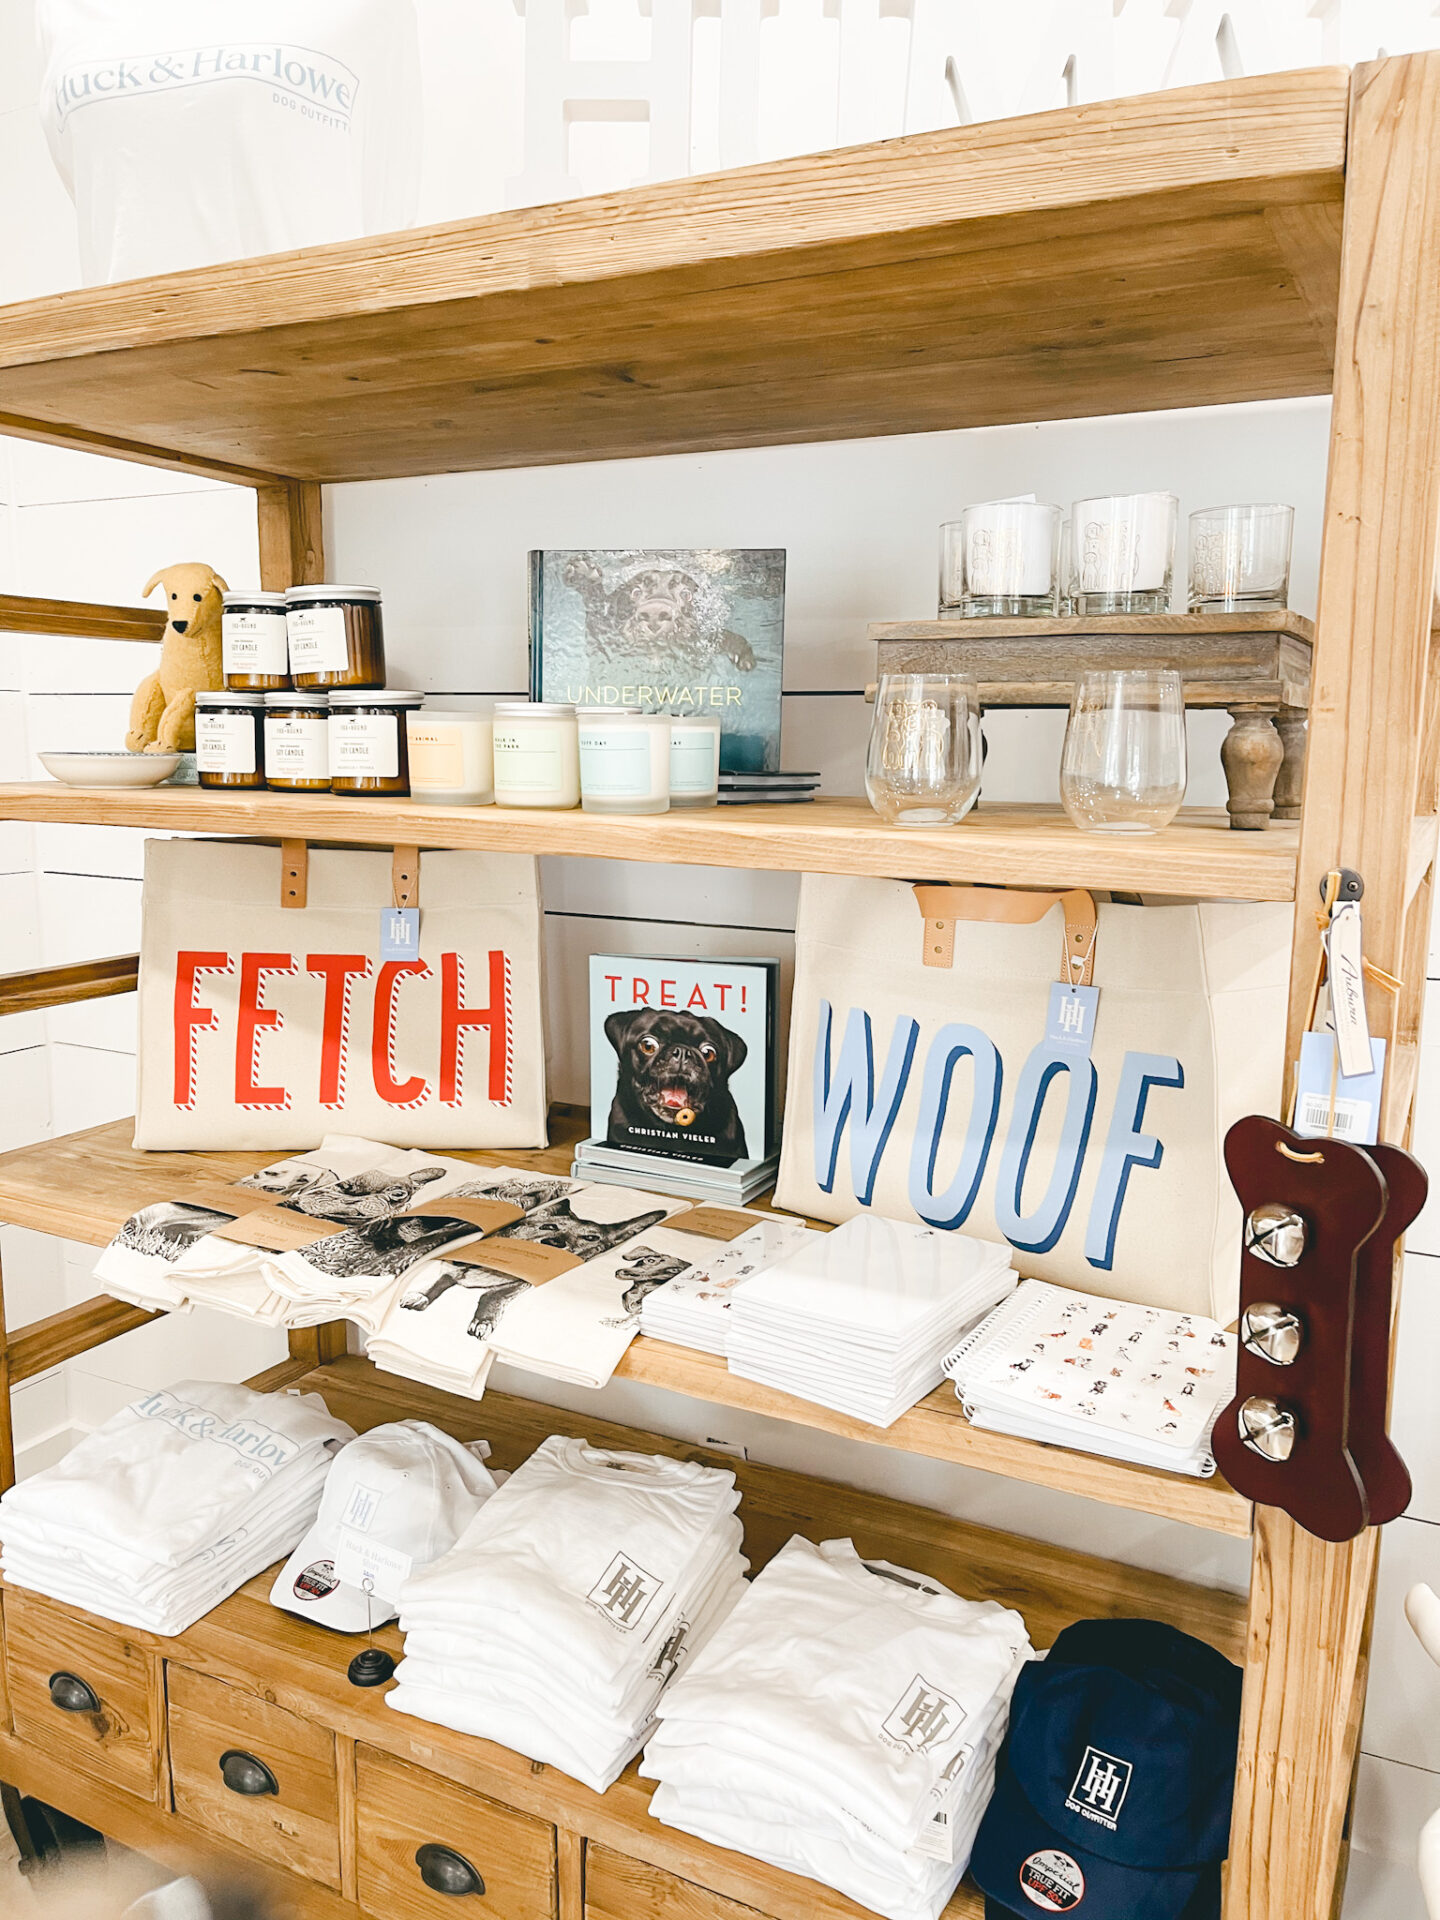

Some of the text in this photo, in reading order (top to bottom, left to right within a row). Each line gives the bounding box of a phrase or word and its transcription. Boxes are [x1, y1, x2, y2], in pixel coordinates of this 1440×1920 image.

[147, 55, 184, 84] &
[191, 47, 351, 110] Harlowe
[272, 93, 297, 111] DOG
[566, 685, 743, 707] UNDERWATER
[604, 974, 747, 1013] TREAT!
[173, 950, 513, 1111] FETCH
[628, 1126, 716, 1143] CHRISTIAN VIELER
[812, 998, 1185, 1271] WOOF
[188, 1416, 216, 1439] &
[1064, 1799, 1118, 1832] DOG OUTFITTER
[1027, 1877, 1048, 1893] UPF
[1029, 1868, 1055, 1889] TRUE
[1052, 1884, 1071, 1900] FIT
